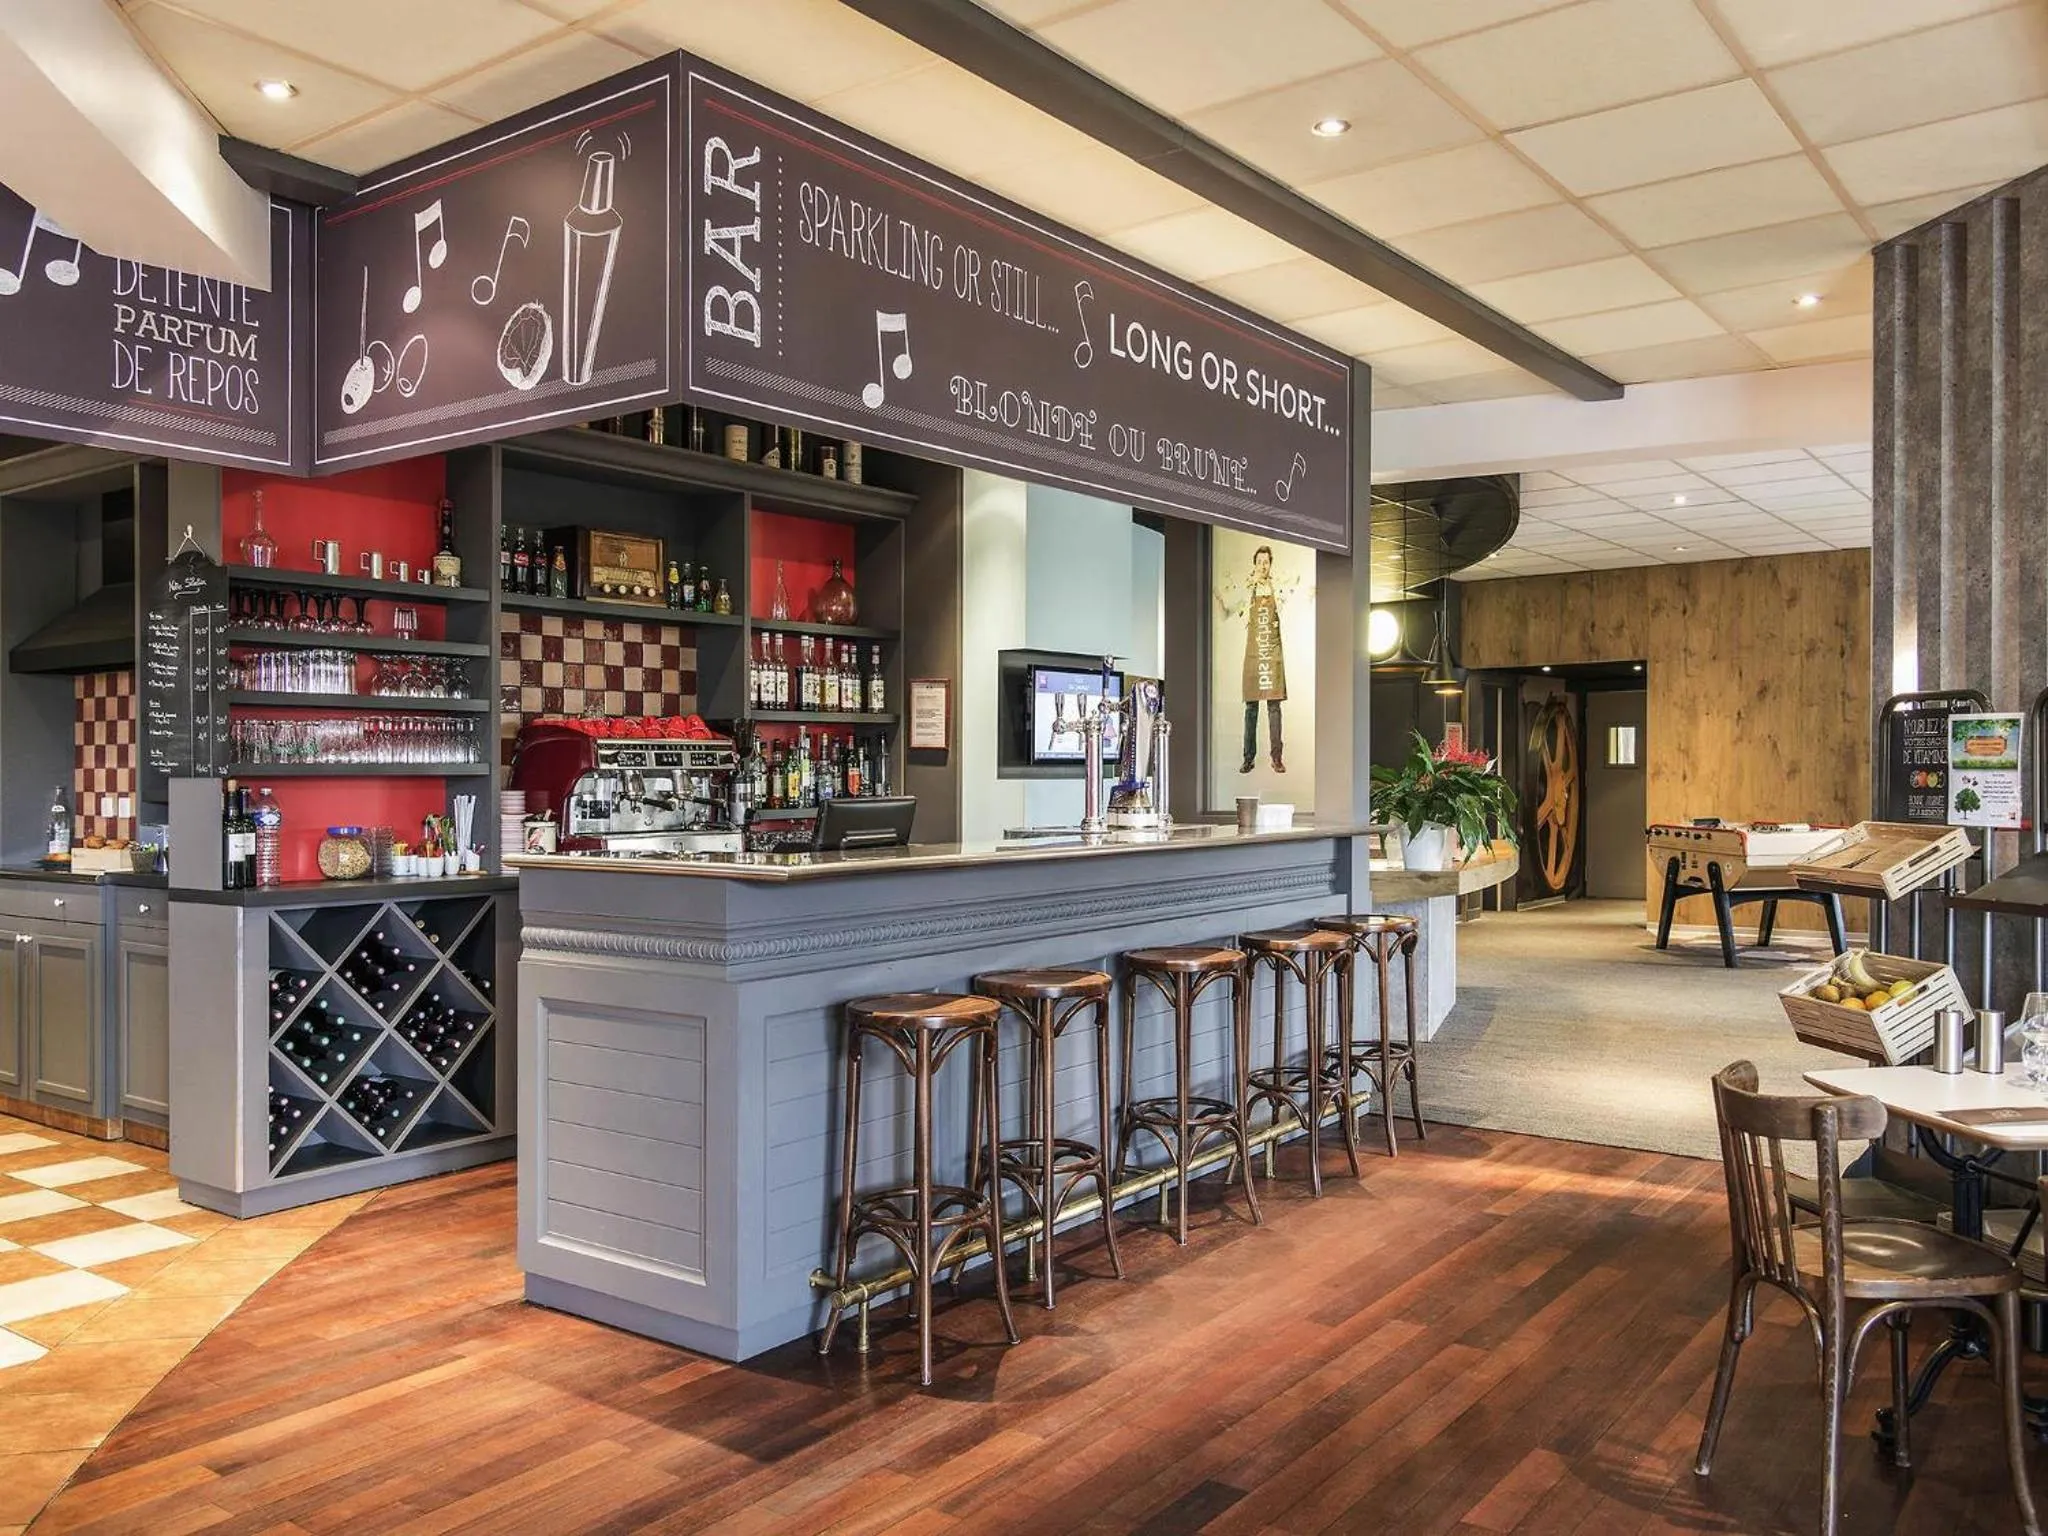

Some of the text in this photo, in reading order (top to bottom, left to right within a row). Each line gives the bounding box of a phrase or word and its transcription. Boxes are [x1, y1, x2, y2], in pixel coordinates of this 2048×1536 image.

[703, 136, 762, 348] BAR
[799, 181, 1060, 334] SPARKLING OR STILL...
[111, 339, 259, 415] DE REPOS
[113, 303, 258, 361] PARFUM
[1109, 313, 1341, 437] LONG OR SHORT...
[949, 375, 1257, 495] BLONDE OU BRUNE...
